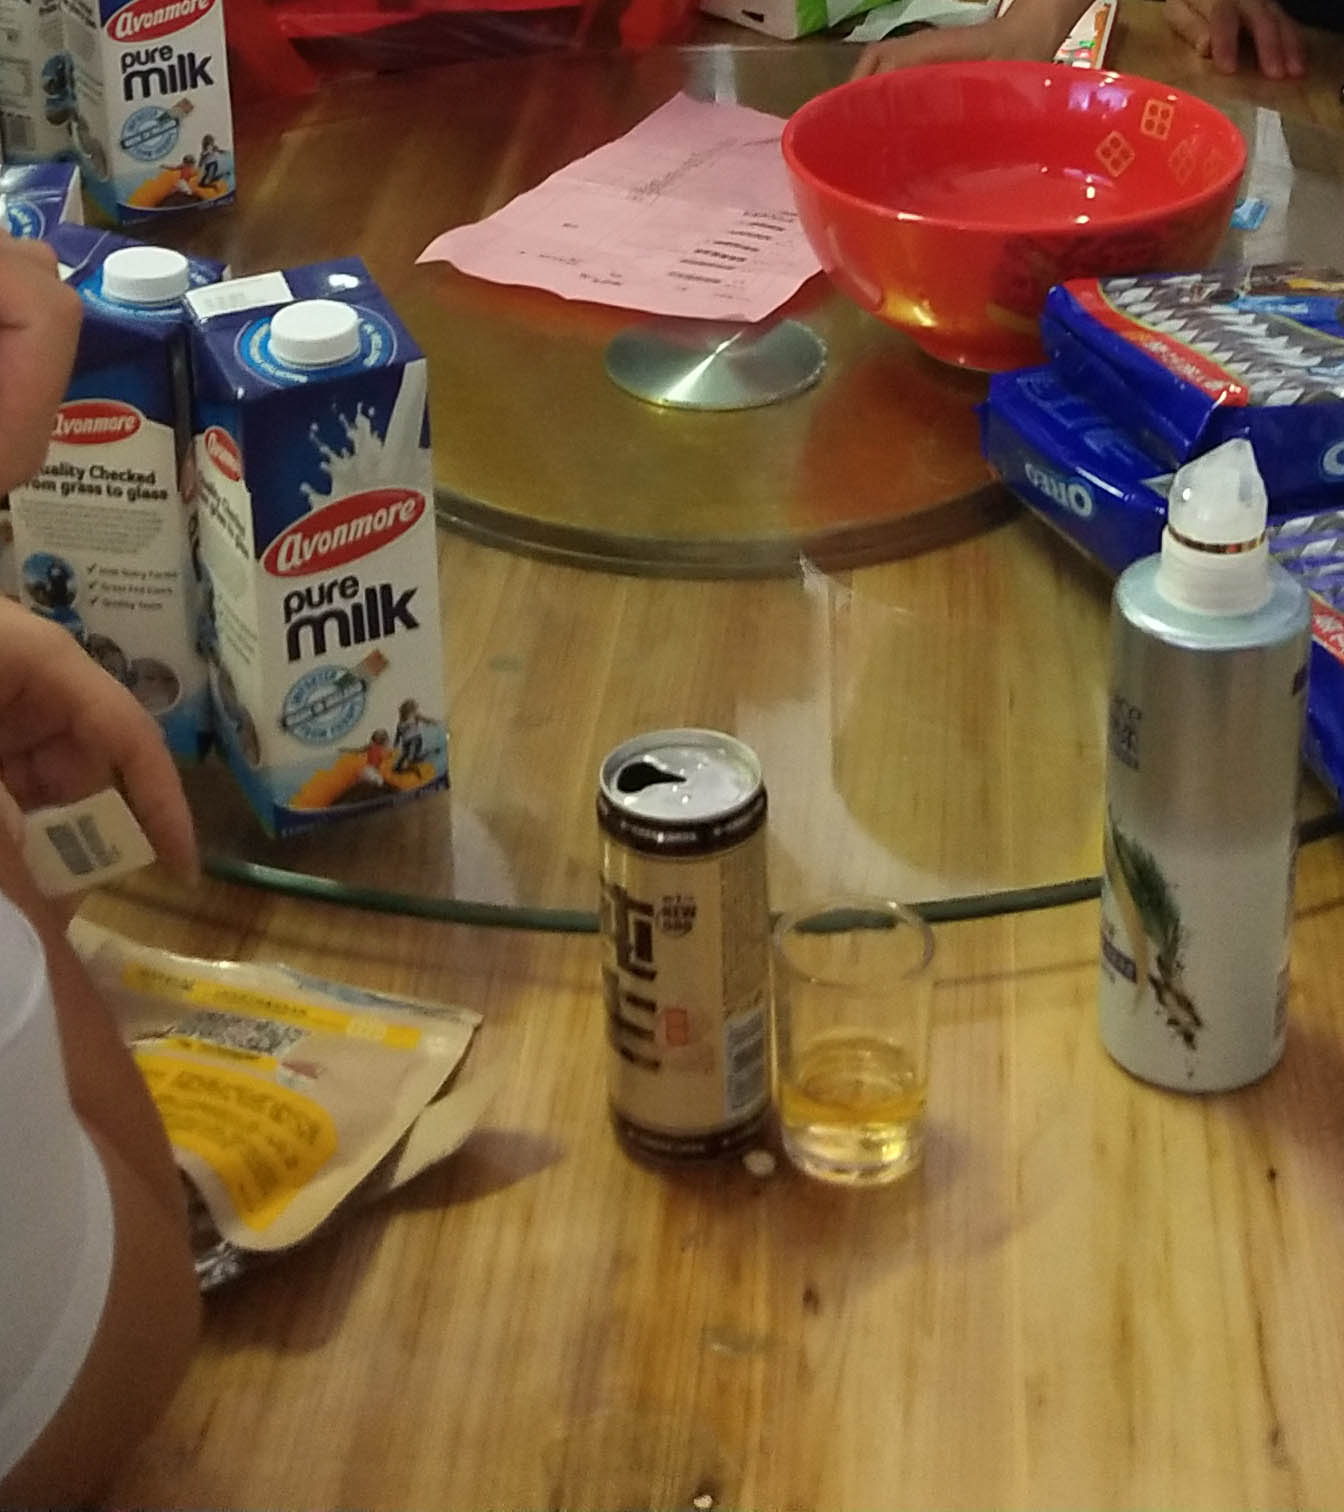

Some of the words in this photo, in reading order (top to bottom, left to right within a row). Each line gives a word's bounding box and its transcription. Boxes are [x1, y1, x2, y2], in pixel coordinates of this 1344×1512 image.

[120, 44, 174, 74] pure
[123, 52, 214, 102] milk
[40, 461, 85, 481] uality
[107, 484, 124, 497] to
[283, 575, 360, 625] pure
[286, 583, 420, 662] milk
